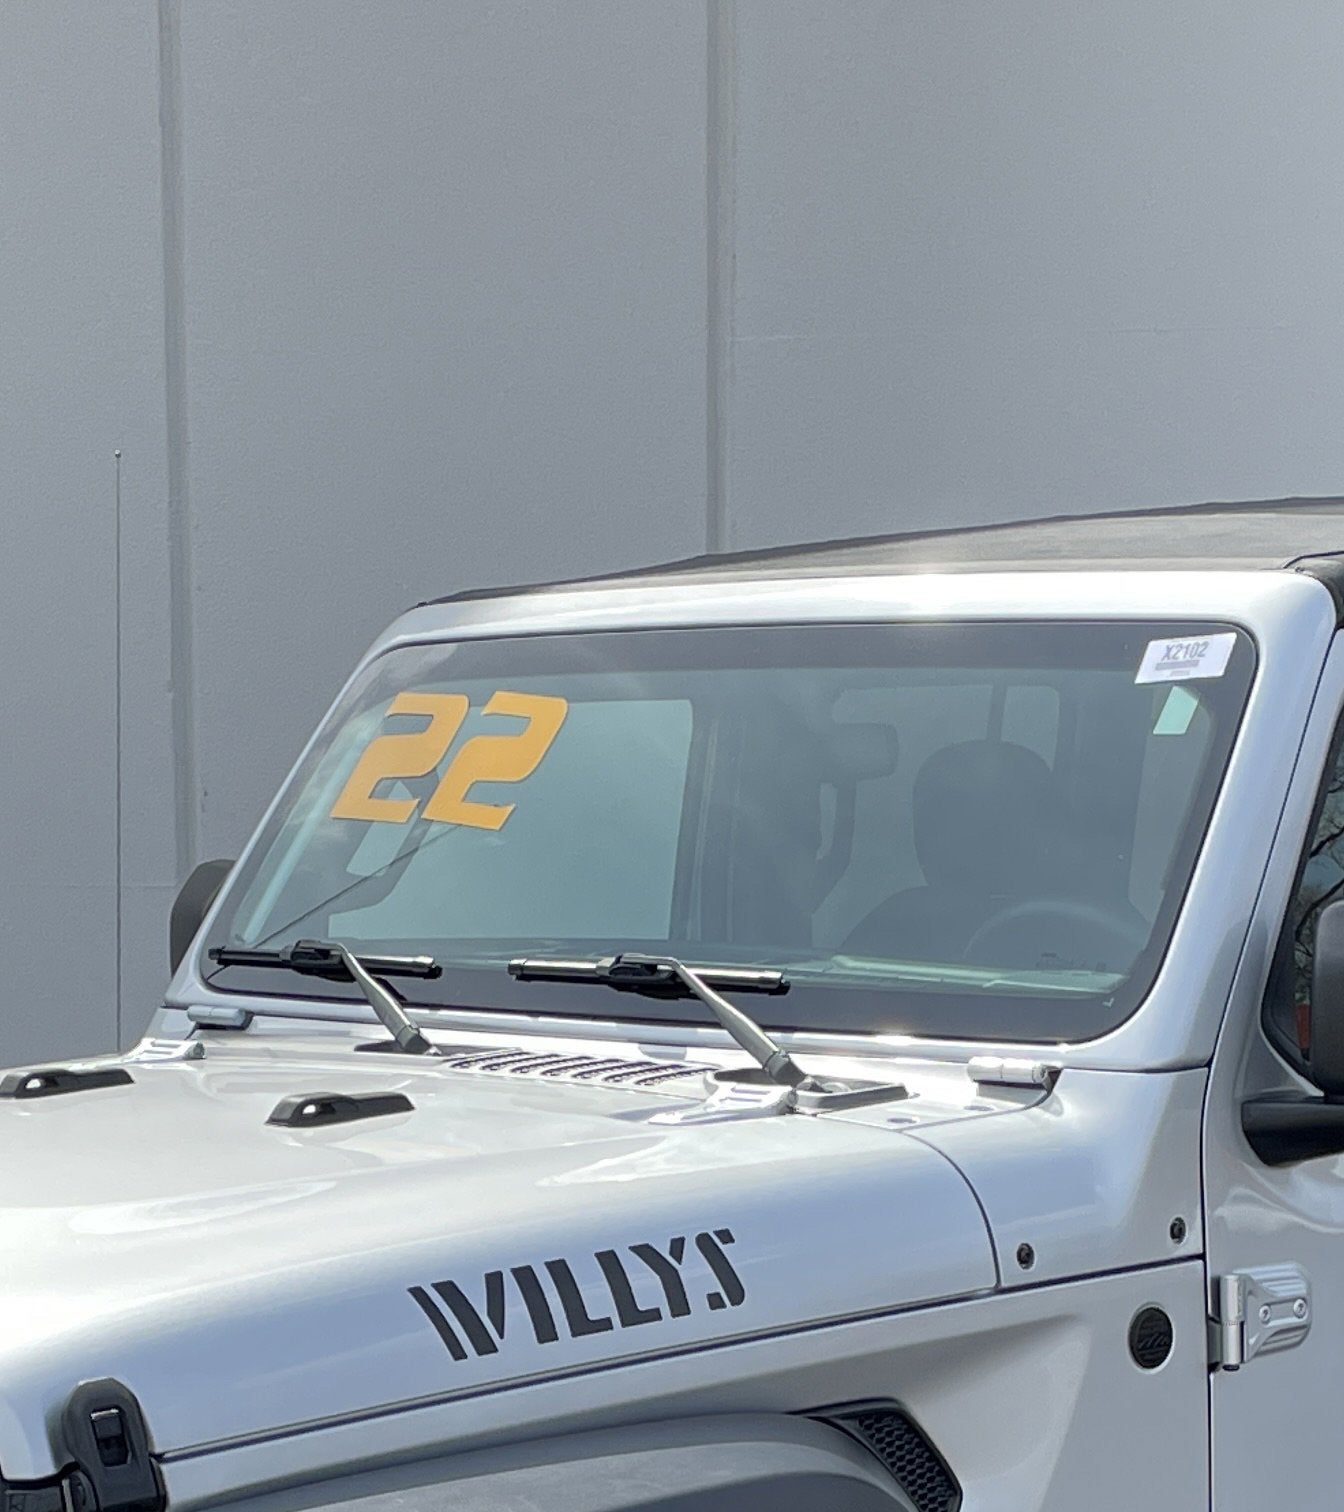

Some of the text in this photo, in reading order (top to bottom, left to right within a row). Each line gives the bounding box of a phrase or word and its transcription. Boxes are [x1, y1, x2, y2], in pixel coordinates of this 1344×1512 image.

[1161, 641, 1210, 661] X2102
[329, 691, 568, 831] 22
[407, 1228, 746, 1361] WILLYS
